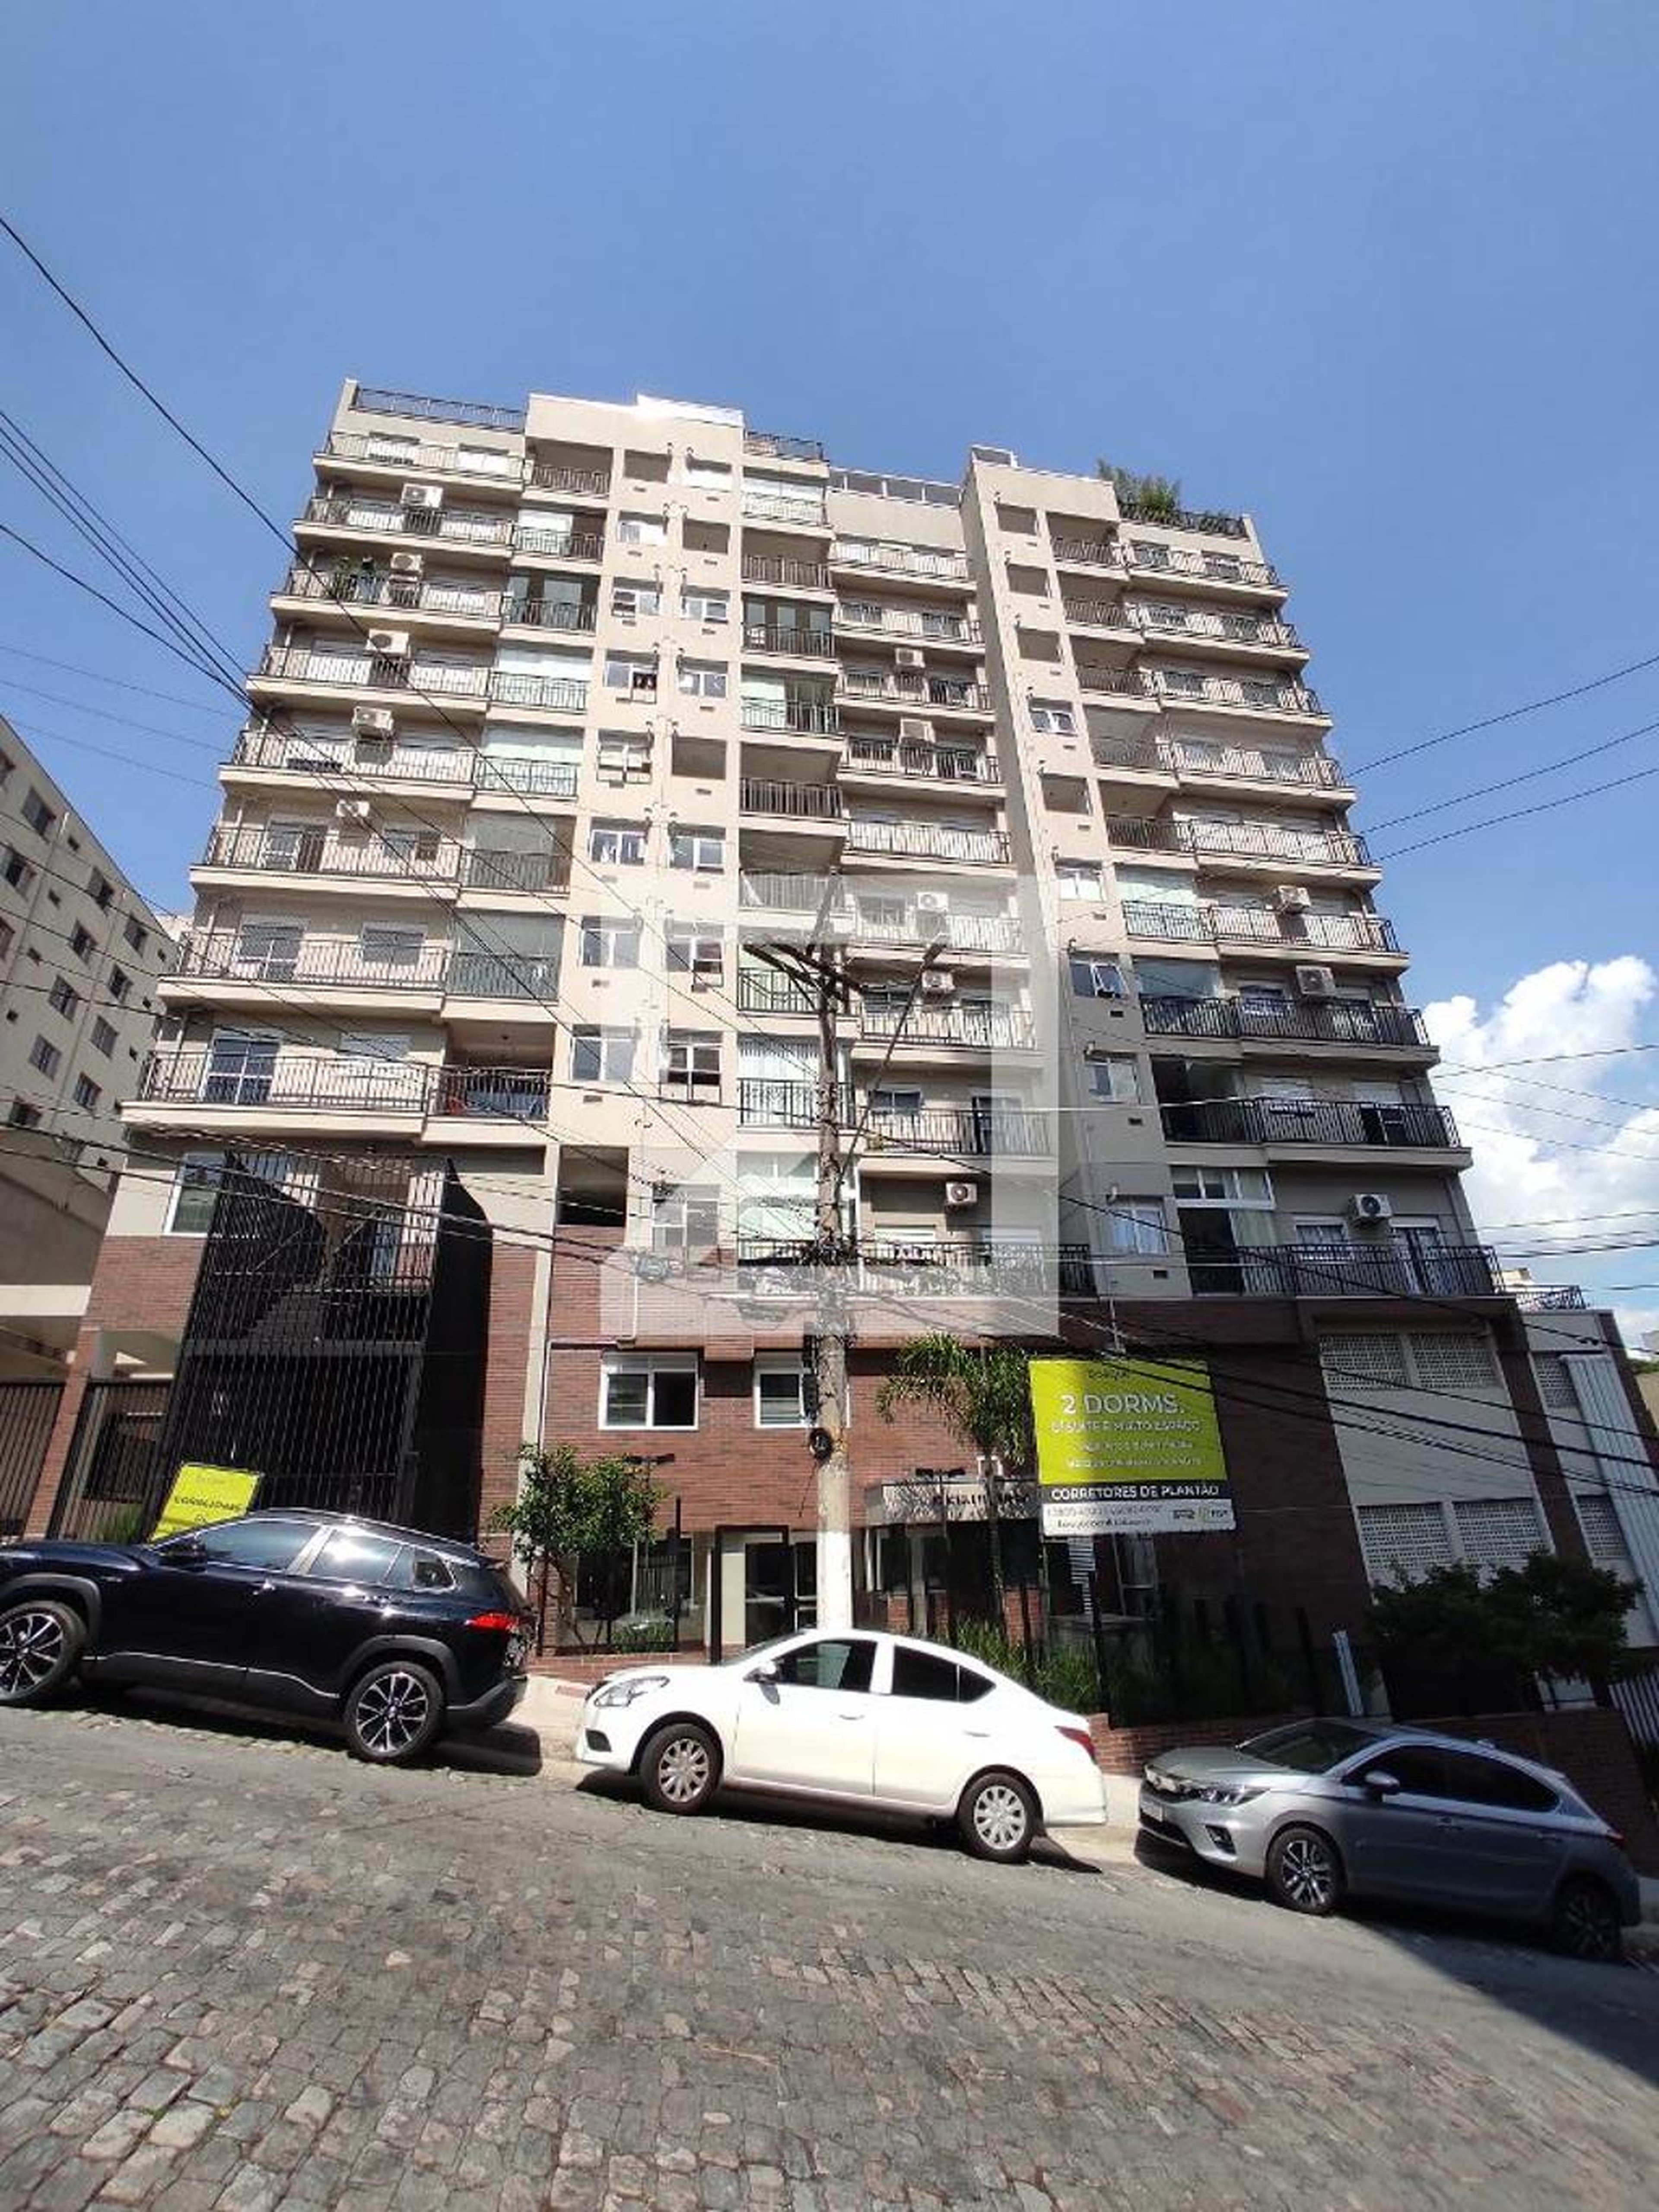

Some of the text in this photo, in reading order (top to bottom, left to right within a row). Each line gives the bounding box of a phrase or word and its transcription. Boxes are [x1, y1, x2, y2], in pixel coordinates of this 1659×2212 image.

[1062, 1392, 1185, 1414] 2 DORMS.
[1051, 1486, 1137, 1500] CORRETORES
[1140, 1485, 1158, 1498] DE
